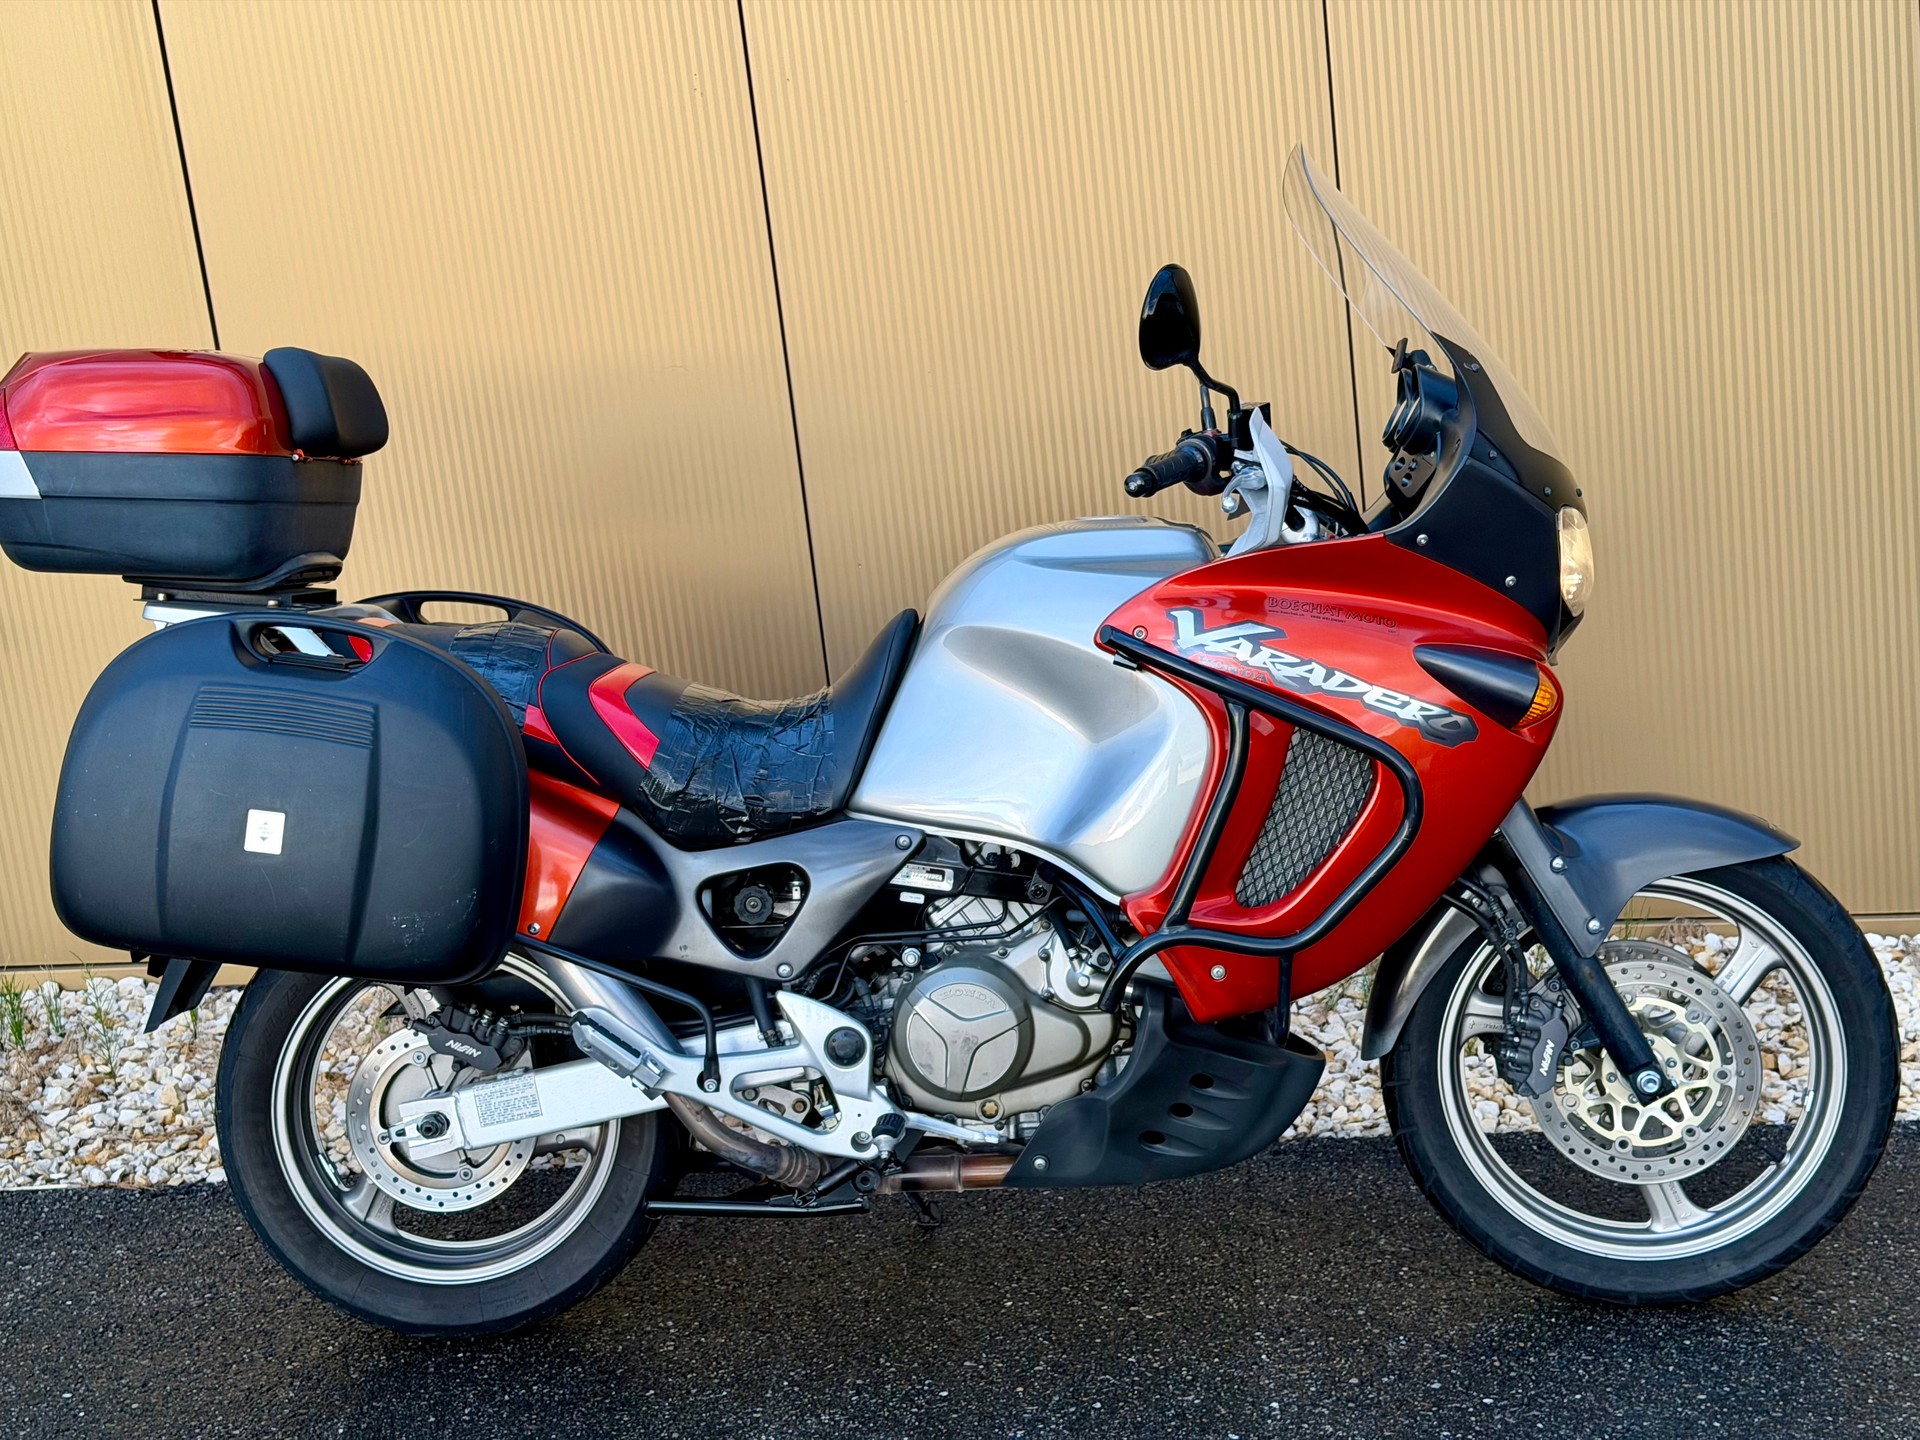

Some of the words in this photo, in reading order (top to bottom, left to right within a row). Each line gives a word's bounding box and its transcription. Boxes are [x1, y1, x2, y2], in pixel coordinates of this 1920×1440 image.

[1268, 596, 1344, 618] BOECHAT
[1345, 609, 1397, 629] MOTO
[1168, 608, 1480, 747] VARADERO
[1199, 654, 1270, 685] HONDA
[940, 986, 997, 1009] HONDA
[445, 1039, 482, 1058] NISSIN
[1539, 1039, 1555, 1077] NISSIN
